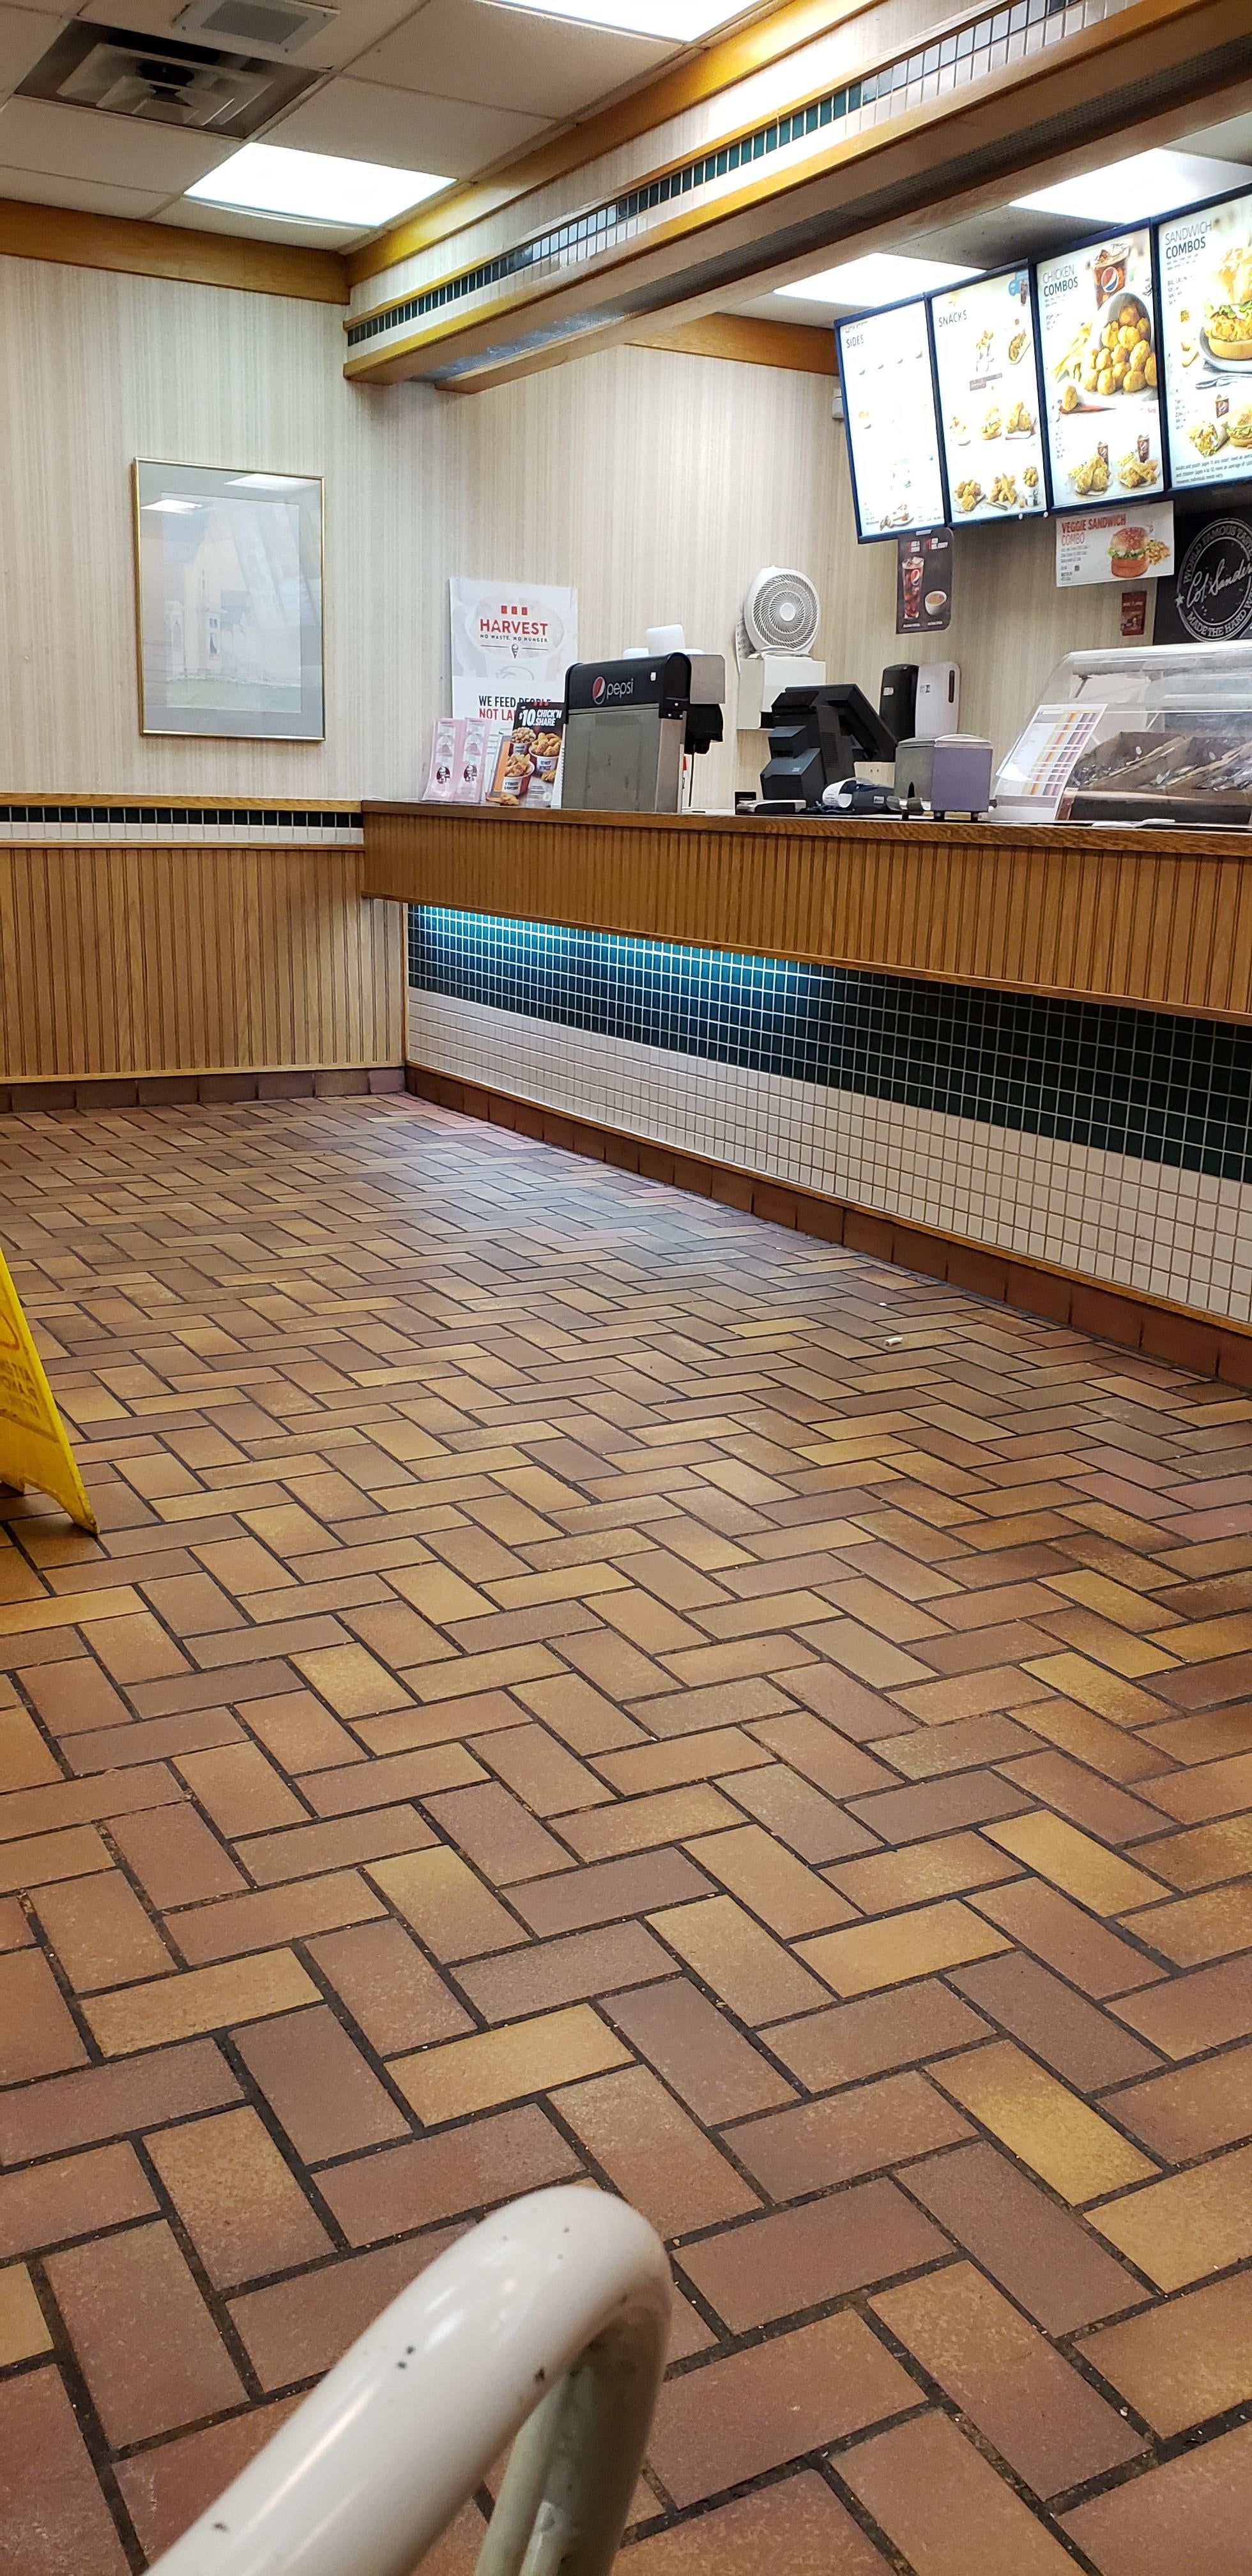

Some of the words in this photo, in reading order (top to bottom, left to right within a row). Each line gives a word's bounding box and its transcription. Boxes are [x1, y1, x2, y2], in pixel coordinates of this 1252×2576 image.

[1165, 220, 1212, 245] SANDWICH
[1166, 236, 1206, 259] COMBOS
[1042, 264, 1075, 284] CHICKEN
[1044, 277, 1078, 297] COMBOS
[939, 310, 967, 327] SNACKS
[846, 335, 864, 348] SIDES
[1062, 518, 1086, 533] VEGGIE
[1088, 514, 1126, 530] SANDWICH
[1062, 532, 1085, 546] COMBO
[1184, 543, 1202, 584] WORLD
[1202, 526, 1237, 545] FAMOUS
[480, 618, 548, 636] HARVEST
[1187, 611, 1208, 635] MADE
[1207, 626, 1225, 637] THE
[1225, 610, 1246, 634] HARD
[606, 678, 634, 699] pepsi
[479, 696, 492, 707] WE
[494, 696, 515, 708] FEED
[480, 709, 499, 720] NOT
[535, 717, 556, 726] SHARE
[537, 710, 562, 718] CHICK'N
